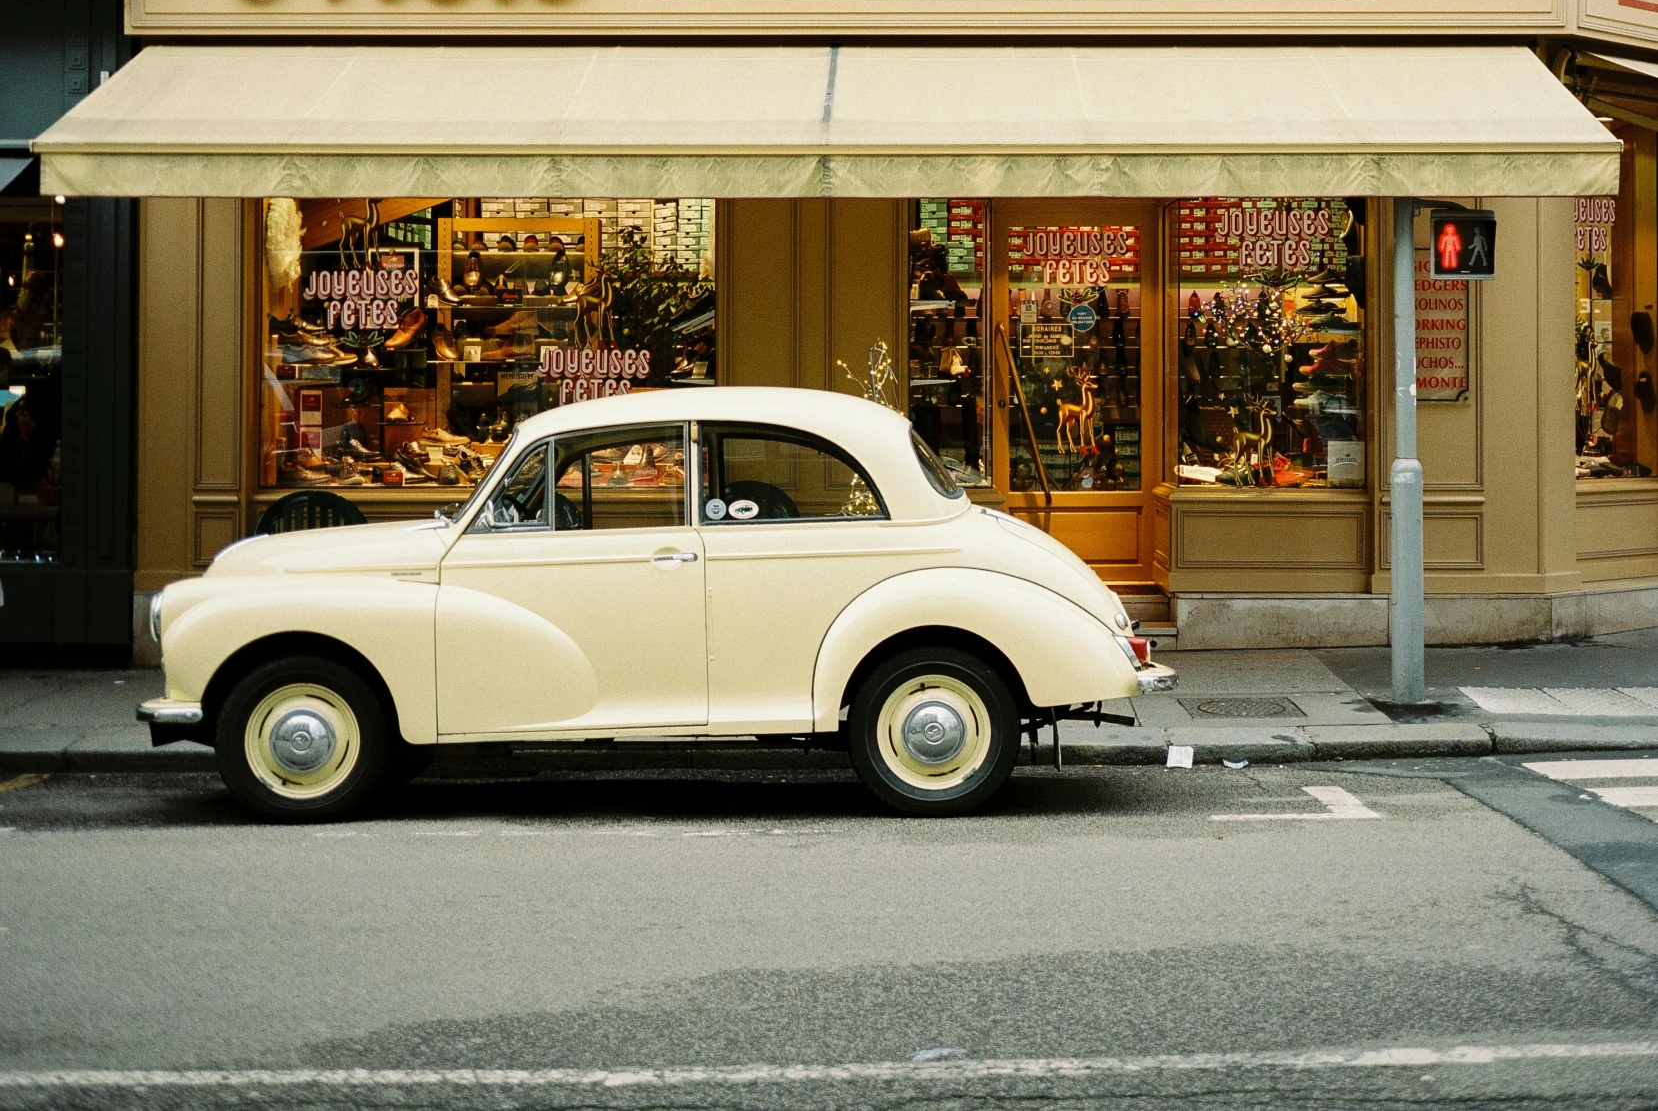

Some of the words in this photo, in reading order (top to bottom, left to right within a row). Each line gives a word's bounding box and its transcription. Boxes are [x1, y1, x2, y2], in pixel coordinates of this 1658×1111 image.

[1215, 209, 1331, 240] JOYEUSES
[1021, 231, 1129, 259] JOYEUSES
[1241, 236, 1312, 270] FÊTES
[303, 270, 419, 300] JOYEUSES
[1044, 256, 1112, 287] FÊTES
[327, 296, 400, 330] FÊTES
[536, 348, 652, 379] JOYEUSES
[559, 375, 632, 406] FÊTES
